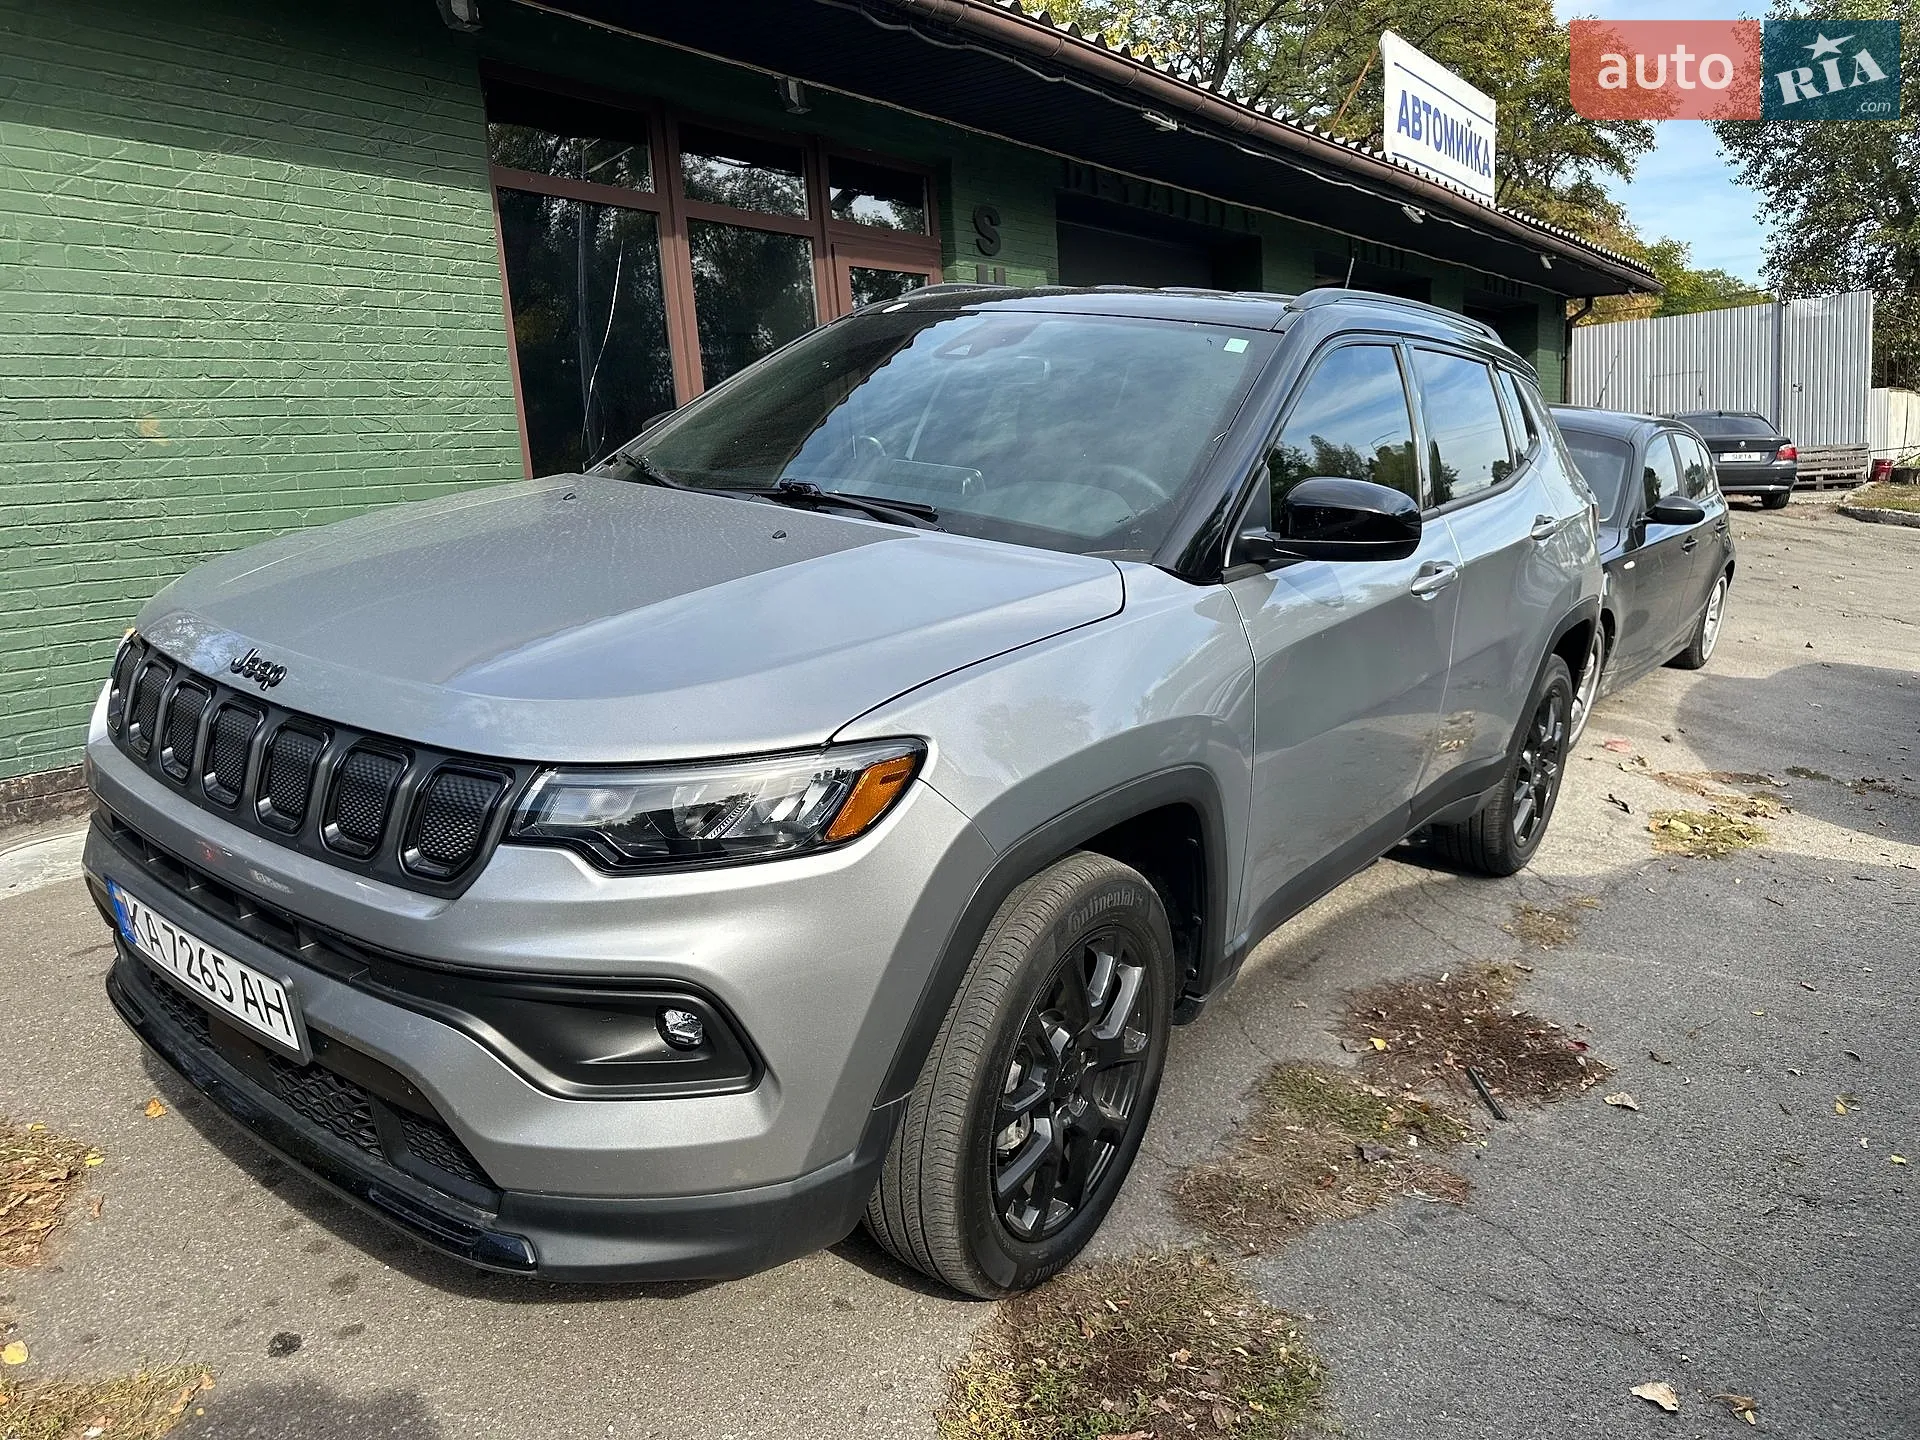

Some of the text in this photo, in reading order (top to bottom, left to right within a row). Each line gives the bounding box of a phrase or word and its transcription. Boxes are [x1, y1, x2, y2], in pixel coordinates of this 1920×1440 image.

[1397, 89, 1492, 178] АВТОМИЙКА
[230, 647, 288, 692] Jeep
[162, 922, 234, 1003] 7265
[239, 969, 292, 1037] AH
